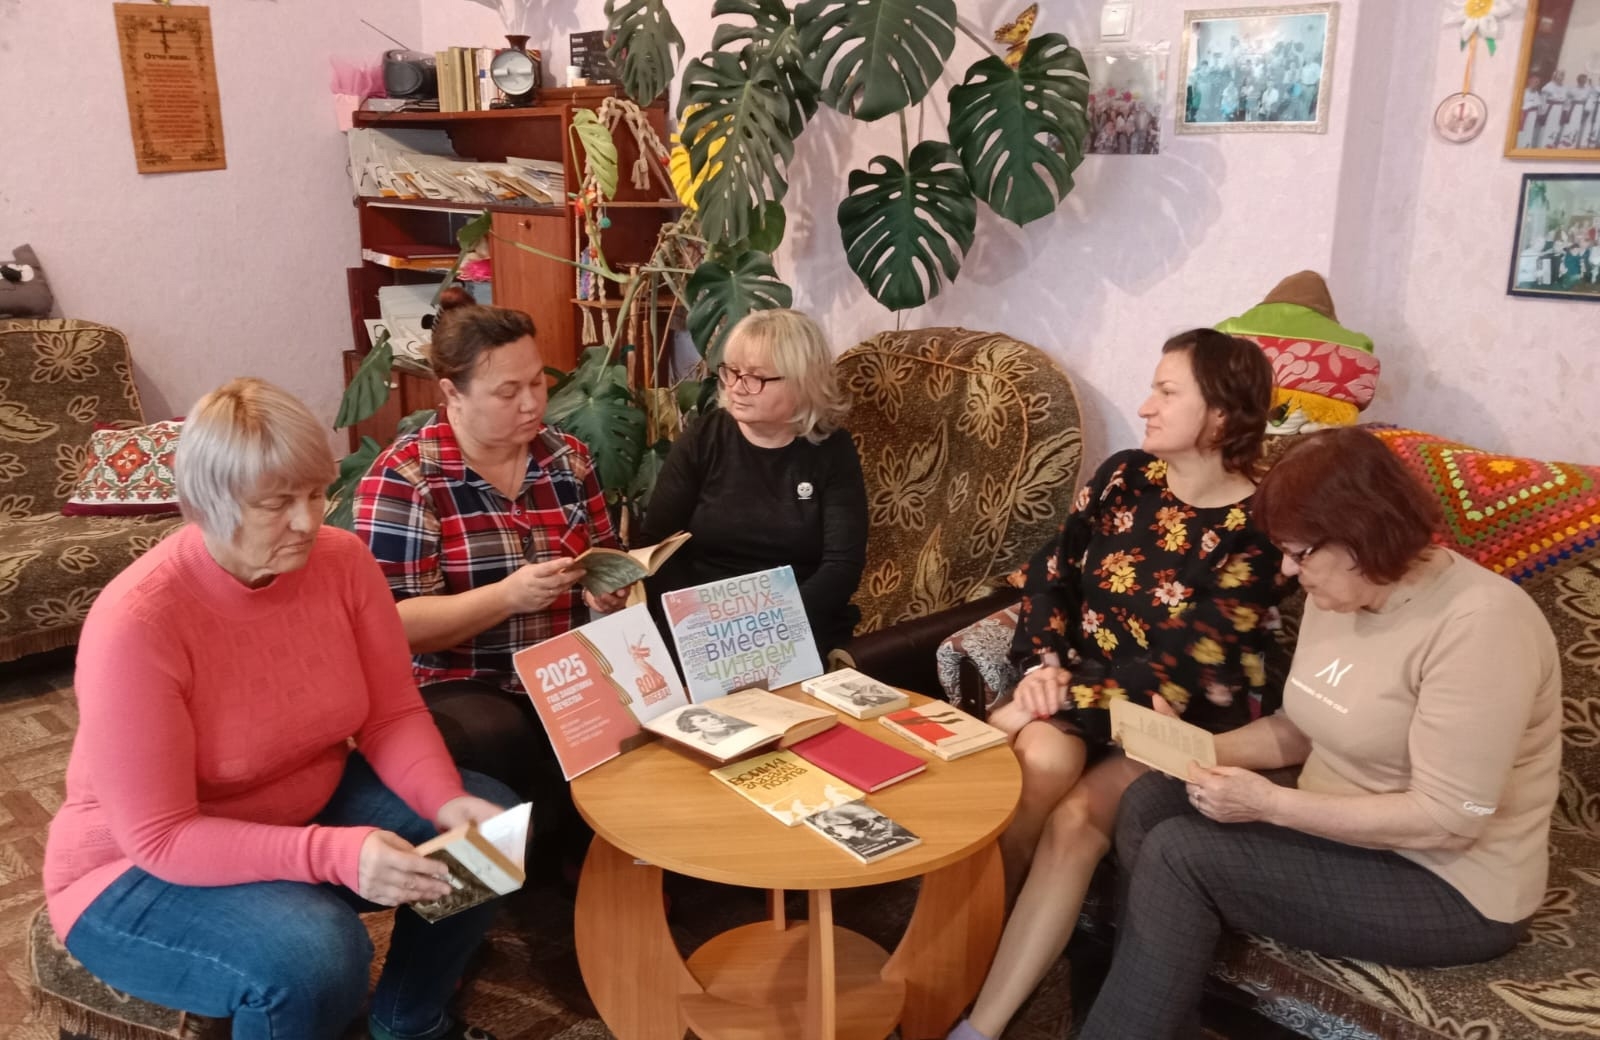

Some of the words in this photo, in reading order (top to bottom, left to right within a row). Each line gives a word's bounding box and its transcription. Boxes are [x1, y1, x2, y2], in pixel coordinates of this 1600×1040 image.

[699, 574, 771, 604] вместе
[707, 591, 776, 621] вслух
[705, 608, 785, 641] читаем
[705, 623, 790, 662] вместе
[535, 653, 588, 693] 2025
[704, 640, 797, 681] читаем
